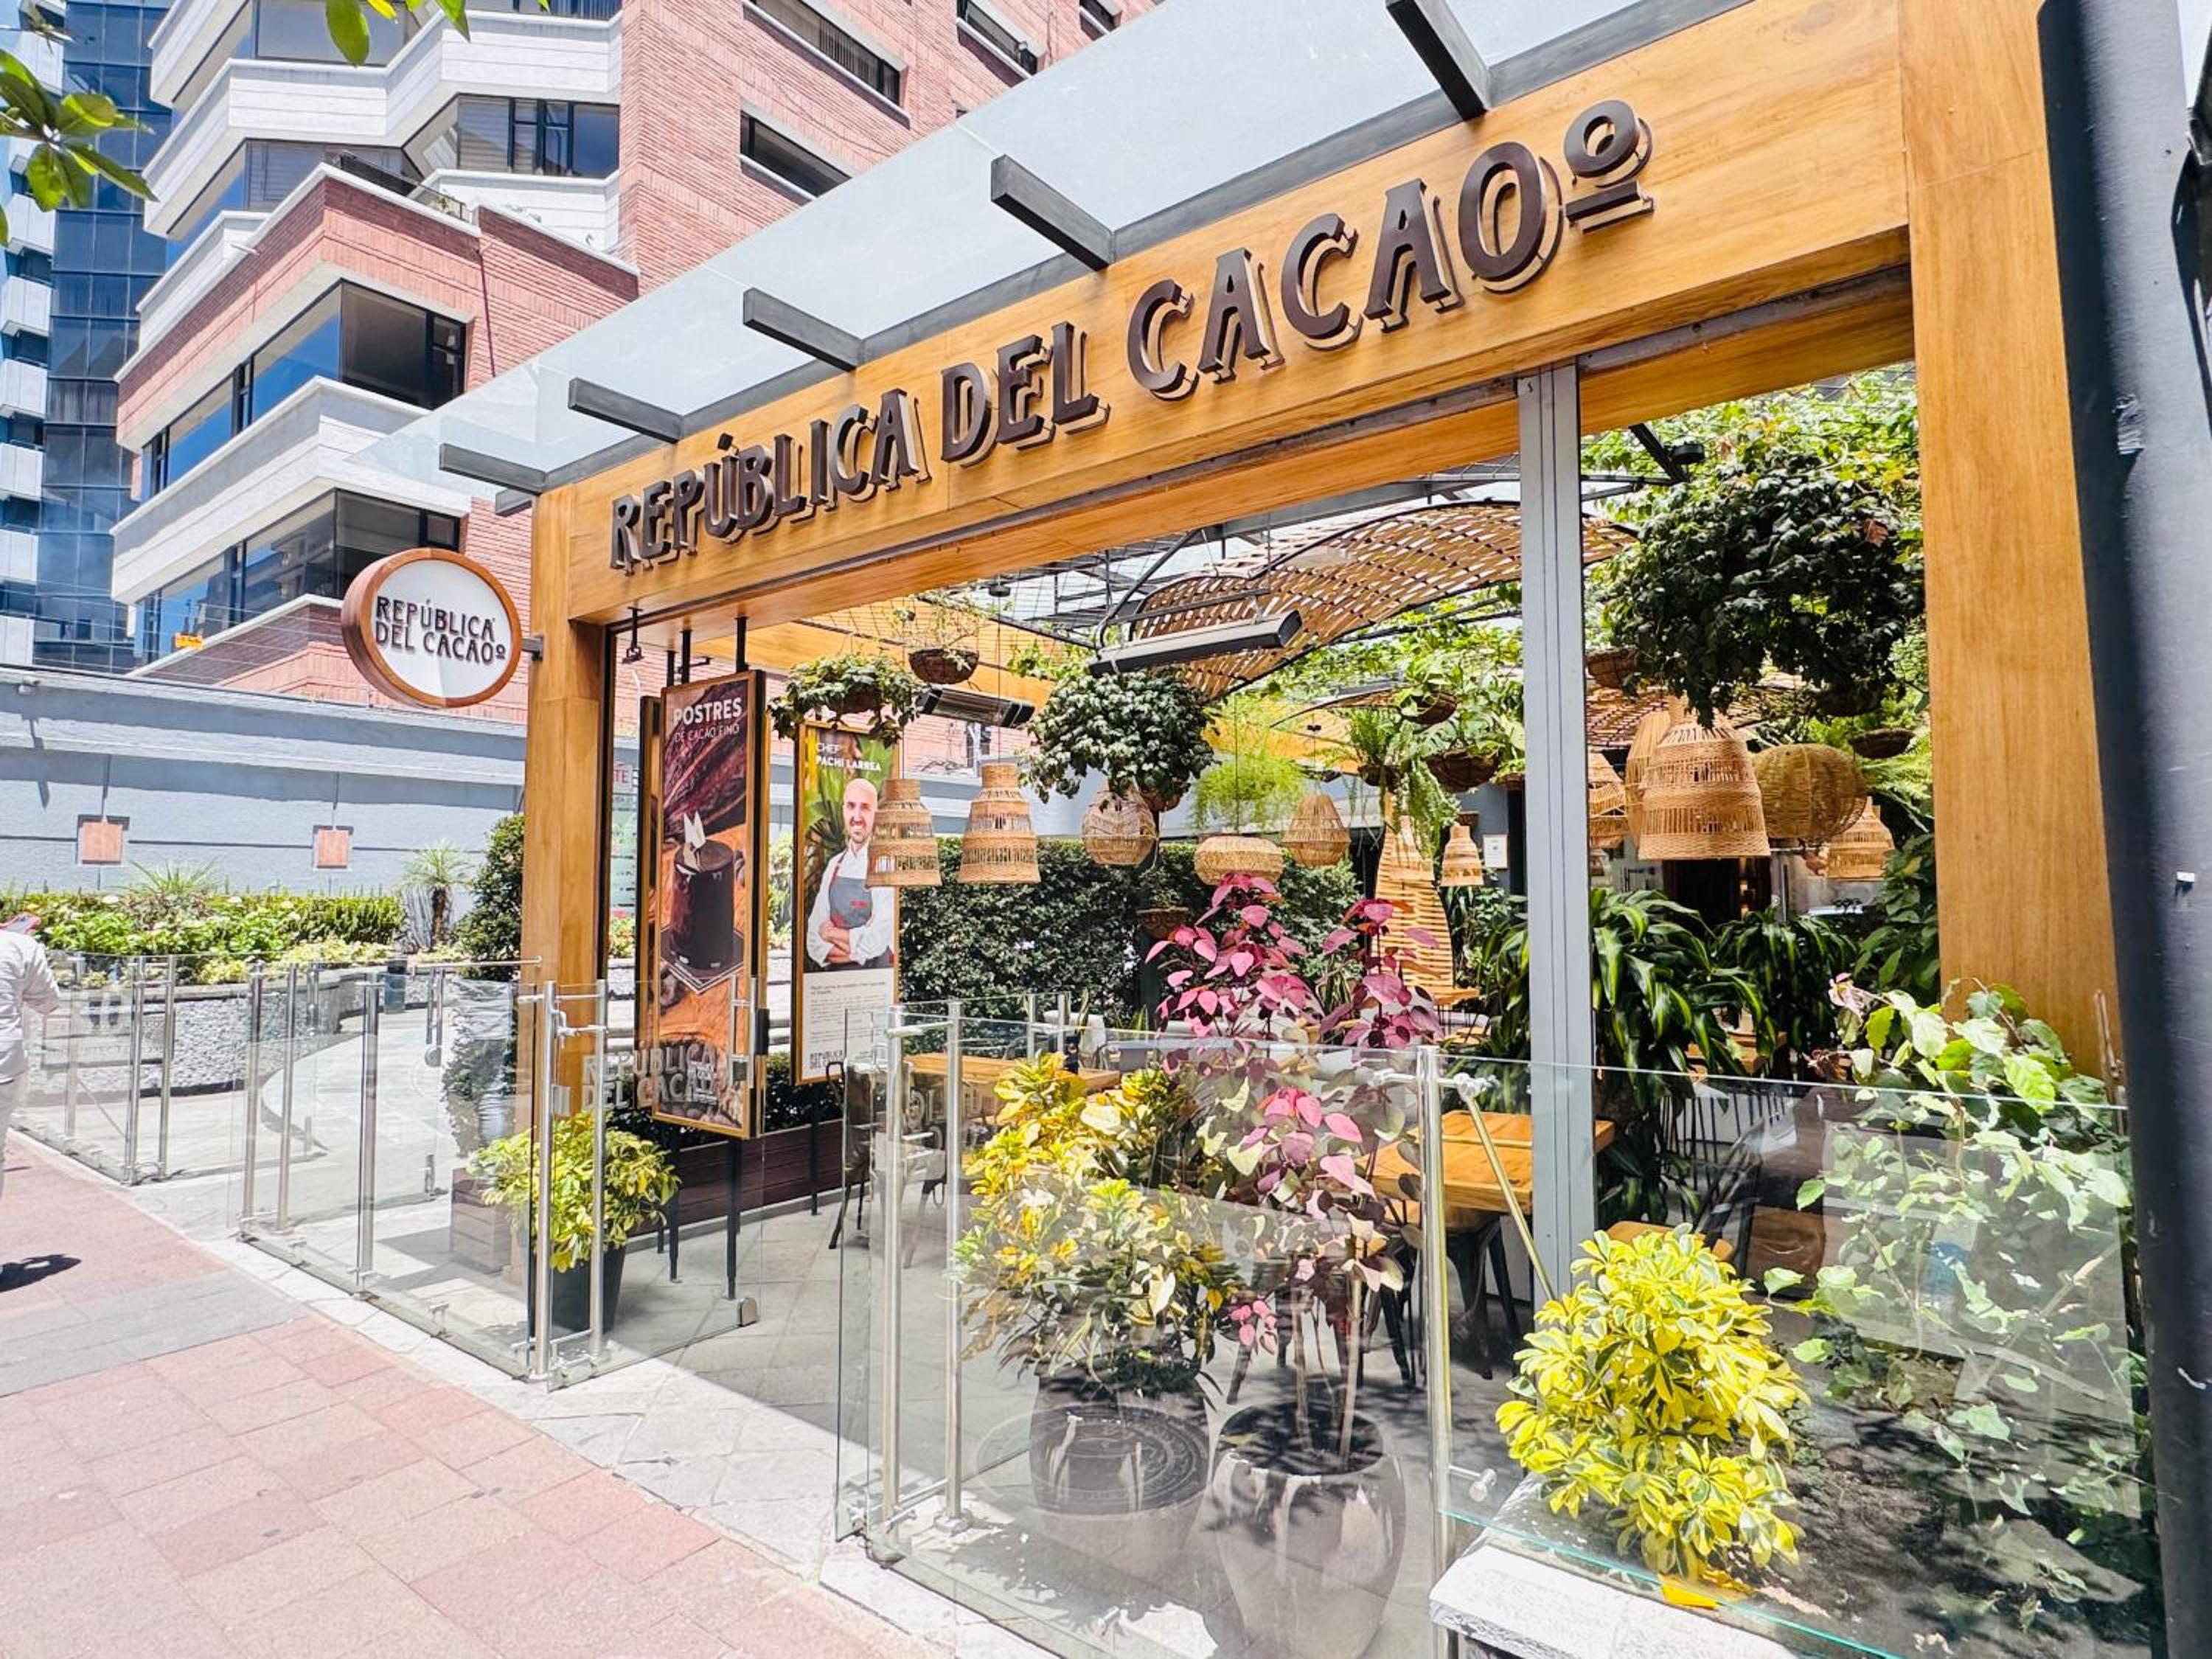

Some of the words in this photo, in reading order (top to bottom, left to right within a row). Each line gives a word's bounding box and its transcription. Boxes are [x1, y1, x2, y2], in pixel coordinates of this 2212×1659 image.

[610, 388, 925, 574] REPÚBLICA
[941, 320, 1107, 466] DEL
[376, 596, 496, 642] REPÚBLICA
[375, 622, 414, 650] DEL
[673, 697, 742, 726] POSTRES
[688, 727, 716, 740] CACAO
[815, 755, 844, 768] PACHI
[816, 743, 840, 753] CHEF
